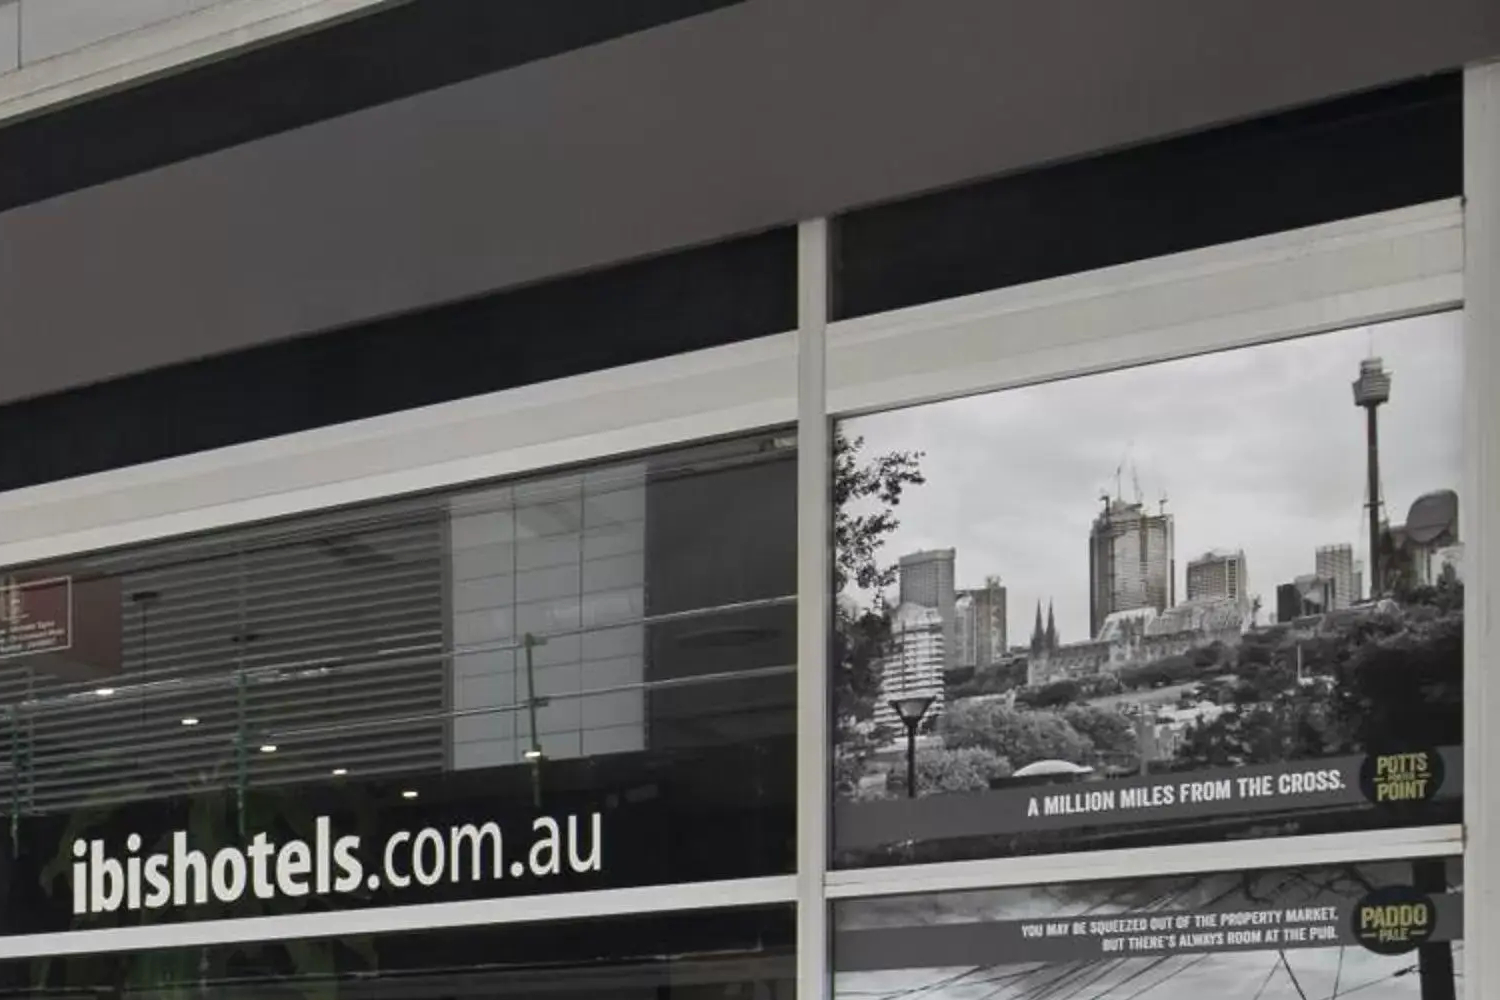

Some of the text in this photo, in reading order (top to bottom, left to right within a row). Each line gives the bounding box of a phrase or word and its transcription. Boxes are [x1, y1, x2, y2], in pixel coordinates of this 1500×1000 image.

[1376, 752, 1429, 775] POTTS
[1027, 768, 1347, 817] A MILLION MILES FROM THE CROSS.
[1376, 780, 1428, 802] POINT
[72, 812, 602, 915] ibishotels.com.au
[1021, 906, 1339, 938] YOU MAY BE SQUEEZED OUT OF THE PROPERTY MARKET.
[1361, 903, 1428, 929] PADDO
[1102, 925, 1339, 952] BUT THERE'S ALWAYS ROOM AT THE PUB.
[1379, 927, 1409, 943] PALE
